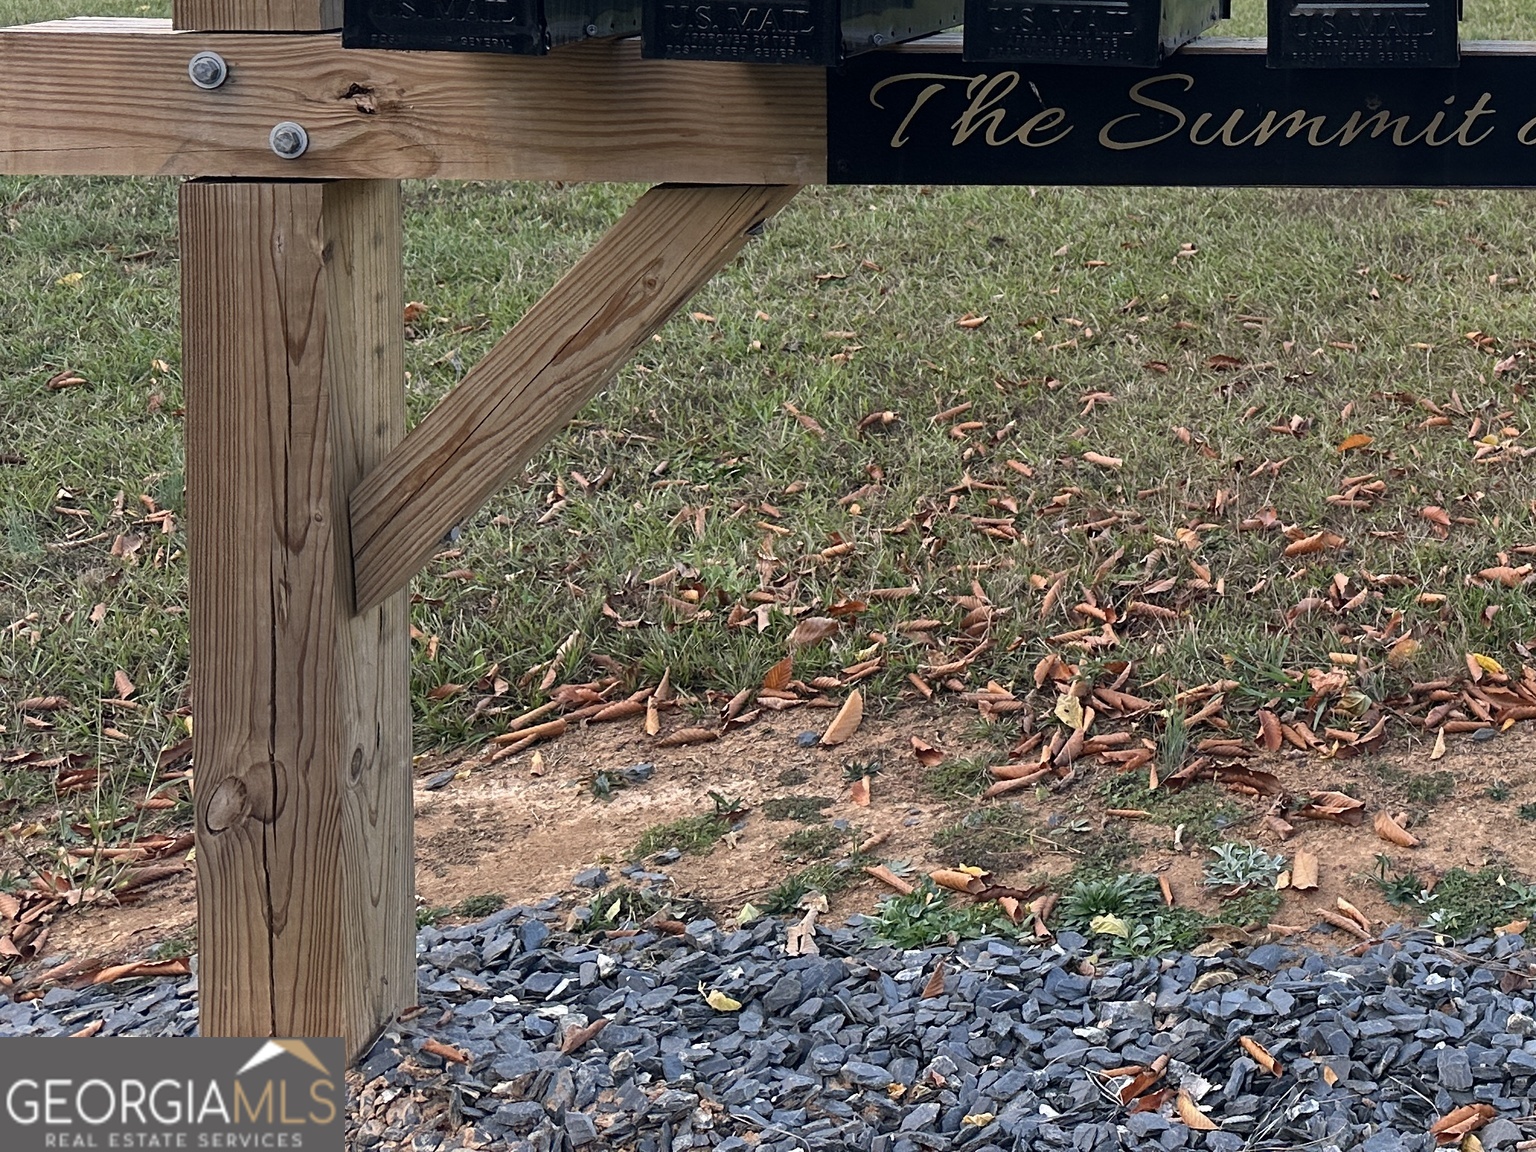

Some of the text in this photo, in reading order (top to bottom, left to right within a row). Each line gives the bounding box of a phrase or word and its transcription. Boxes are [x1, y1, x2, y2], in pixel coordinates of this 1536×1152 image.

[664, 5, 815, 34] U.S. MAIL
[868, 71, 1074, 149] The
[1098, 73, 1495, 151] Summit
